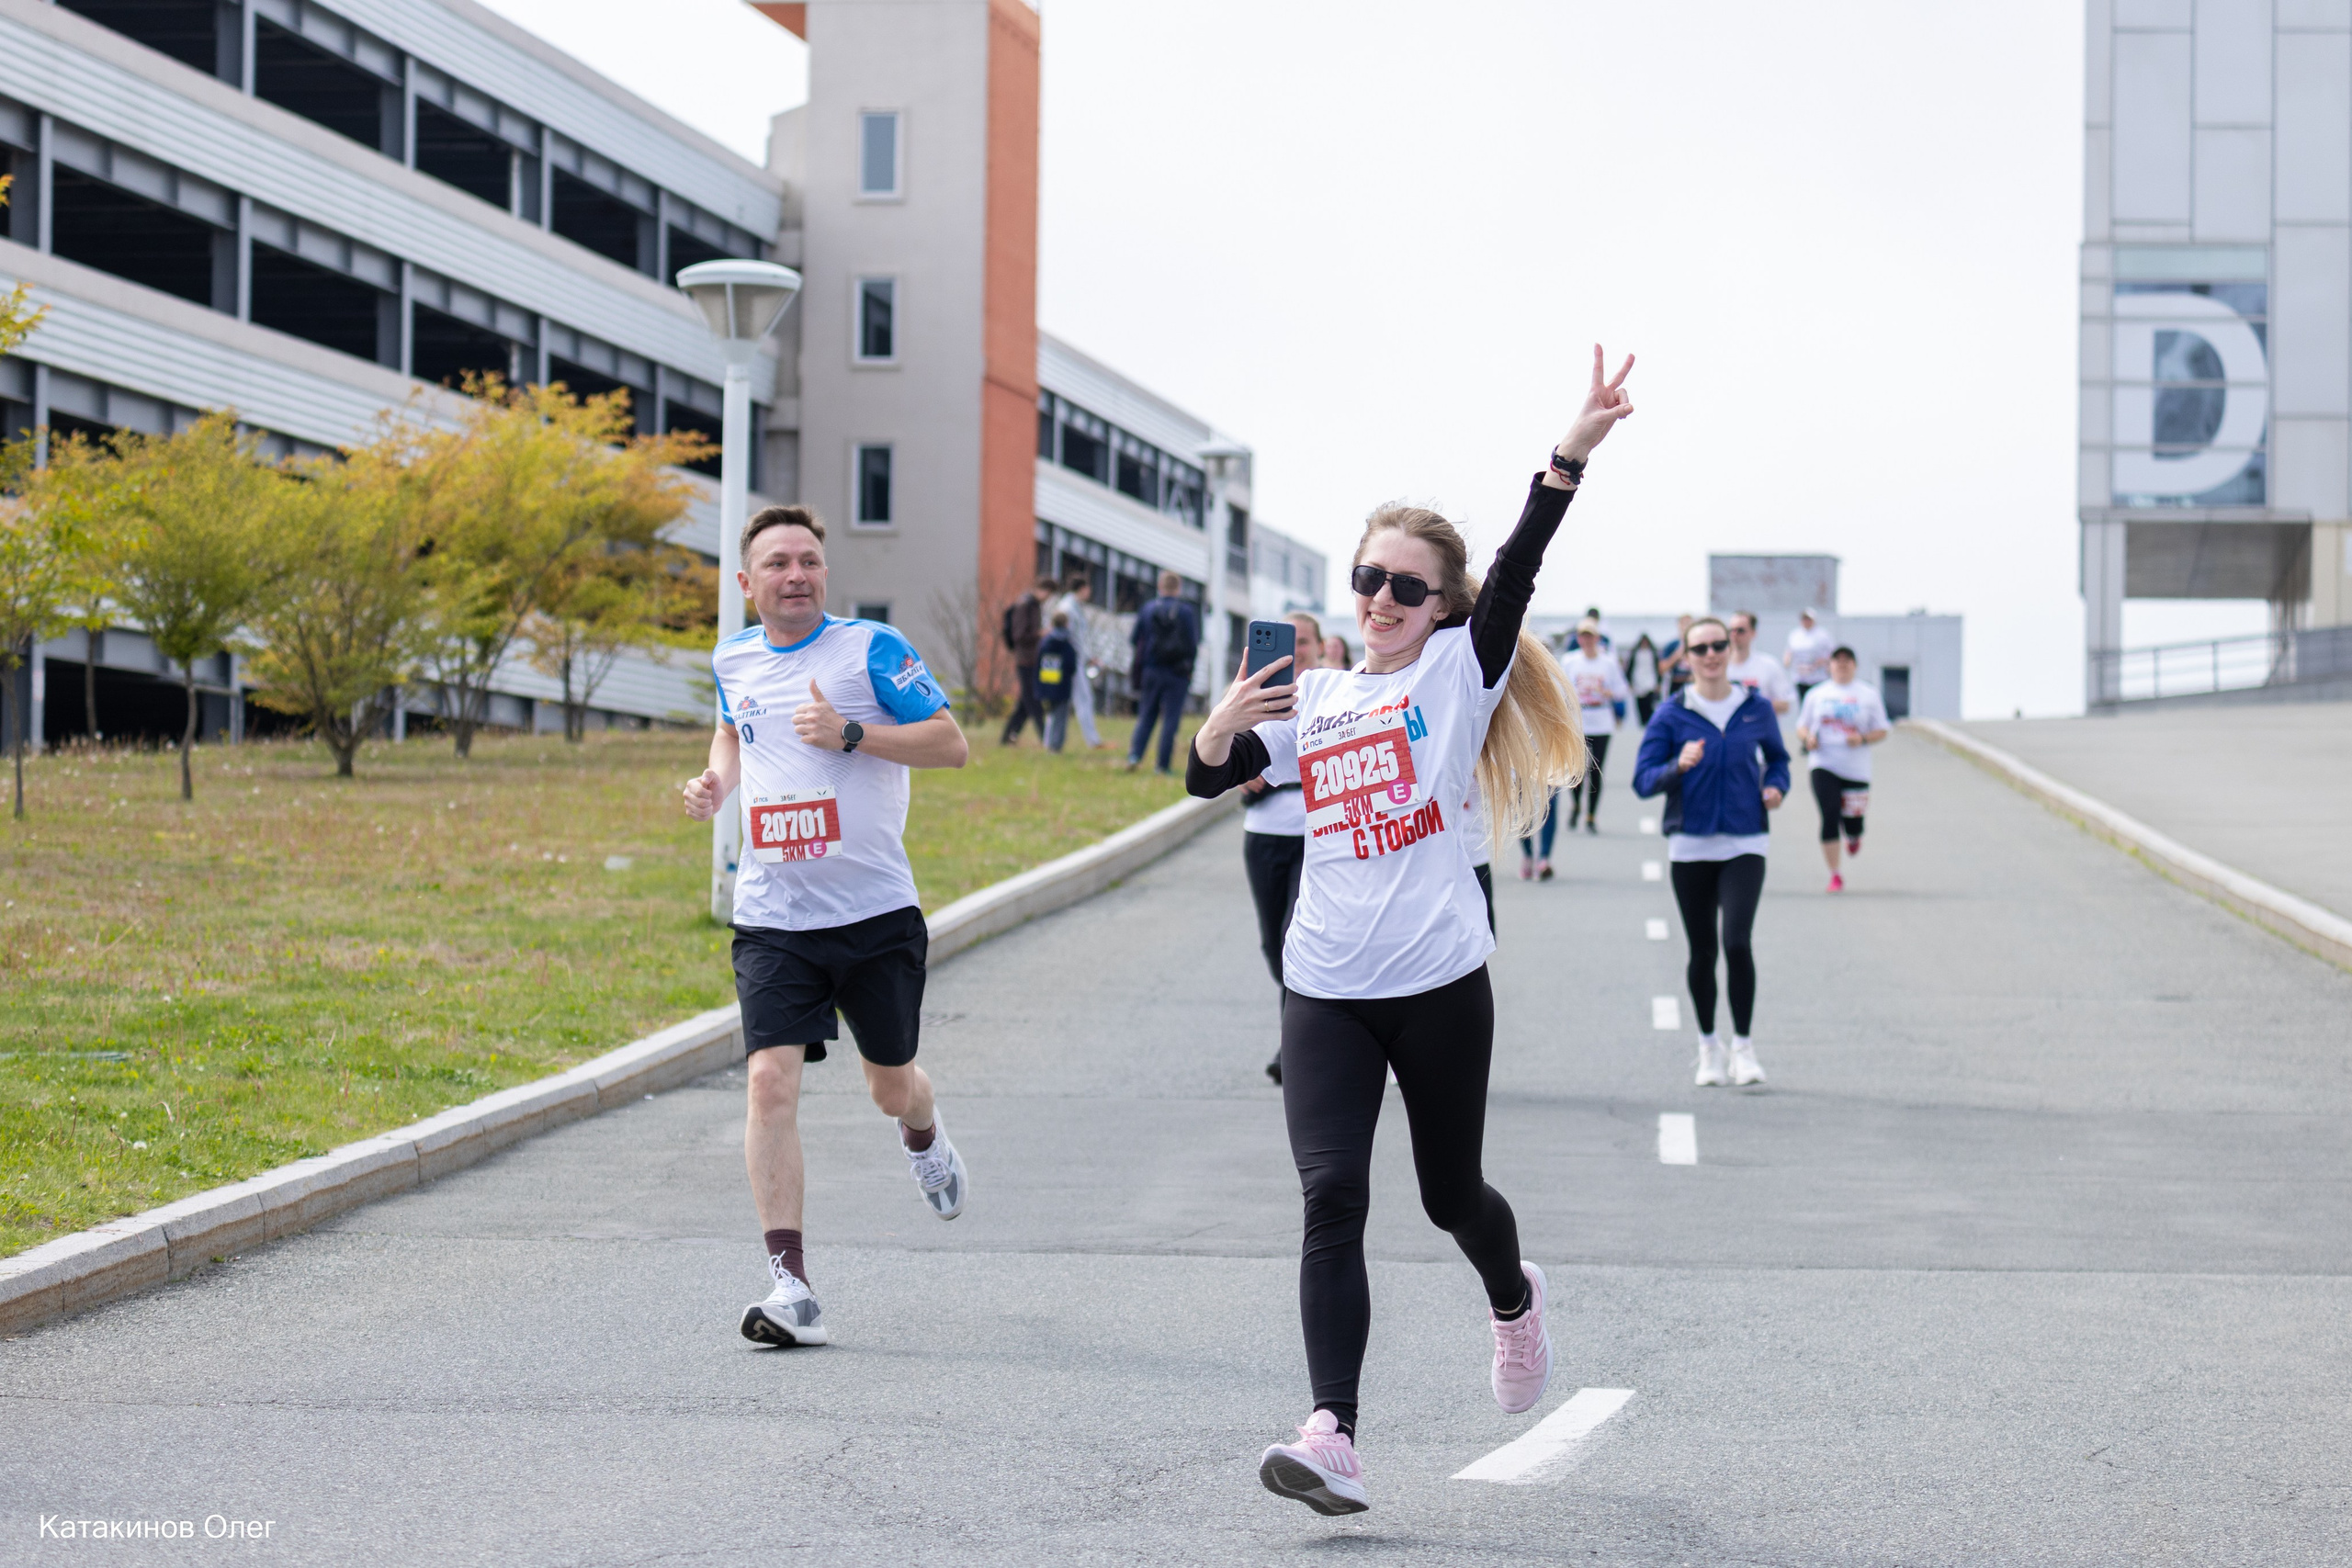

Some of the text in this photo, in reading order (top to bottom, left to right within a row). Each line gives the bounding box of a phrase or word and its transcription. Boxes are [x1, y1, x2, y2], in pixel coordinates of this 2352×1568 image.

[2113, 292, 2267, 495] D
[1309, 739, 1323, 748] ПСБ
[1403, 705, 1429, 742] Ы
[1311, 741, 1400, 801] 20925
[760, 807, 827, 842] 20701
[1352, 829, 1370, 860] С
[1369, 795, 1445, 856] ТОБОЙ
